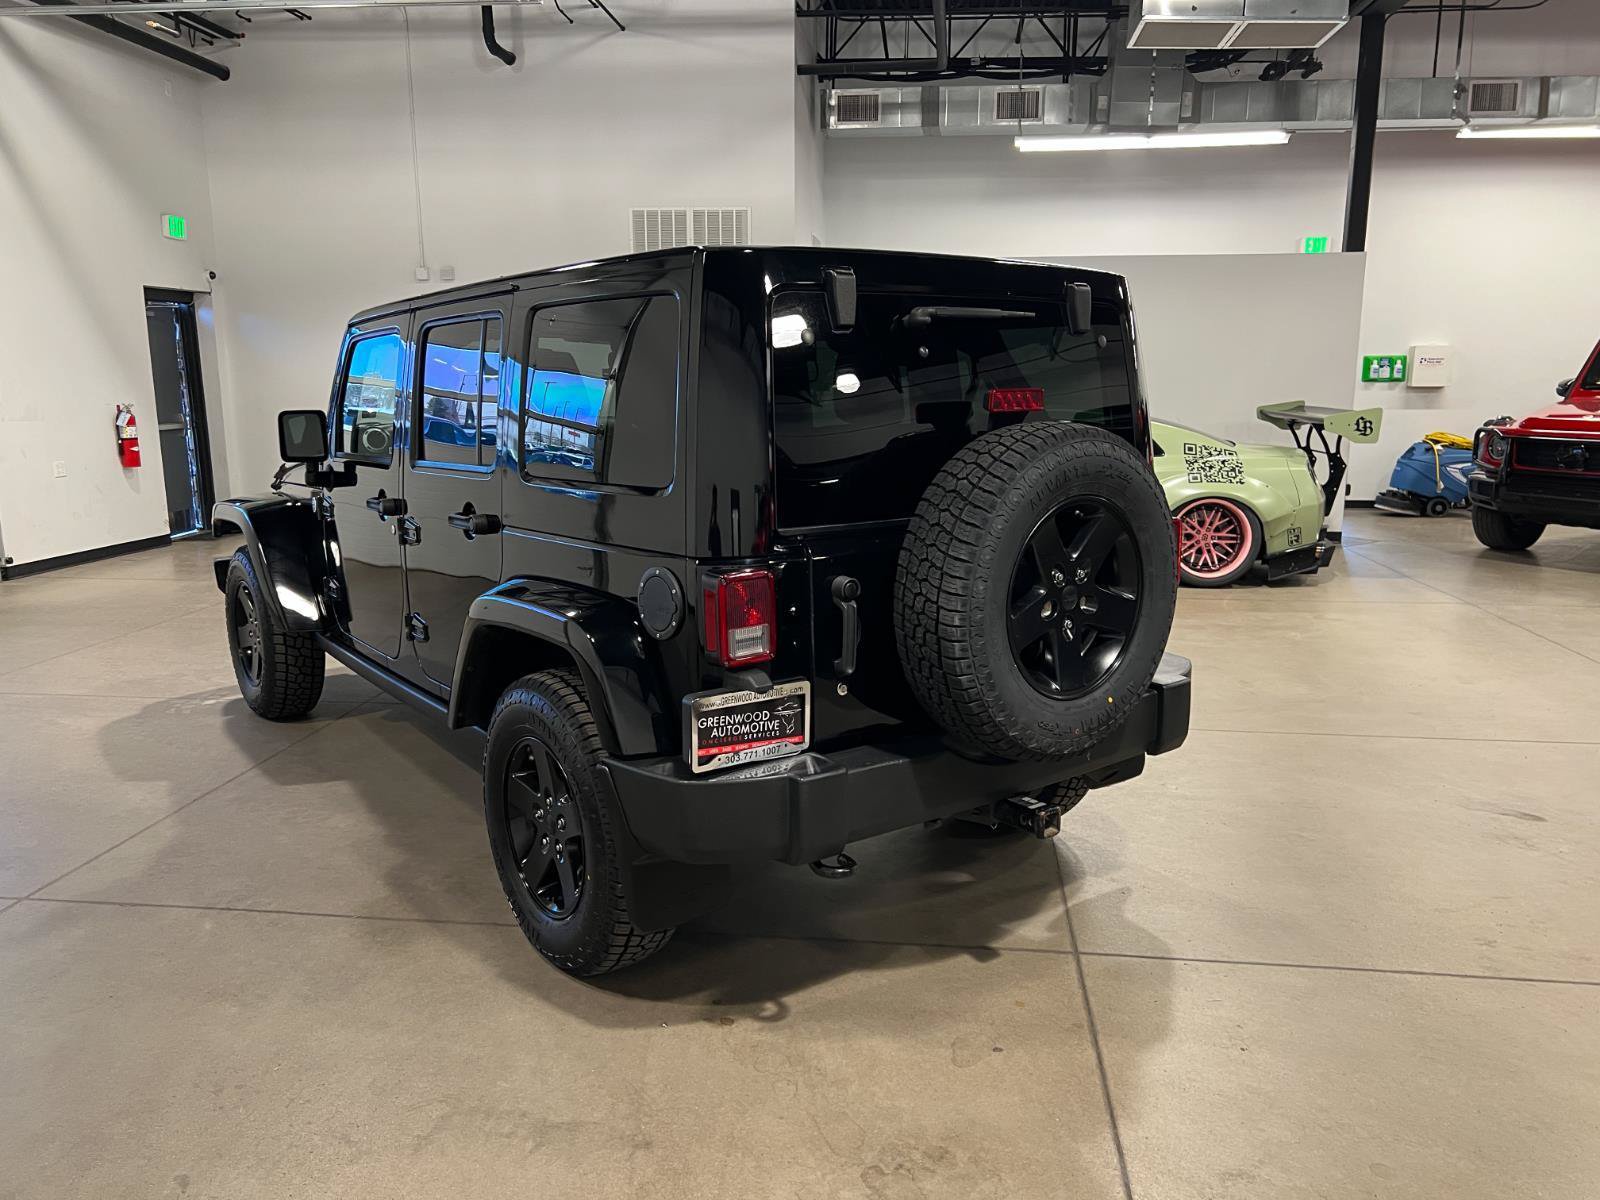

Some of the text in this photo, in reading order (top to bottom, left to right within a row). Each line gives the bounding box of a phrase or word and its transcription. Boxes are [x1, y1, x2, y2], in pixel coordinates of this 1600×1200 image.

[1304, 236, 1328, 254] EXIT
[698, 710, 770, 729] GREENWOOD
[710, 719, 780, 738] AUTOMOTIVE
[744, 730, 780, 740] SERVICES
[725, 745, 780, 764] 303.771.1007
